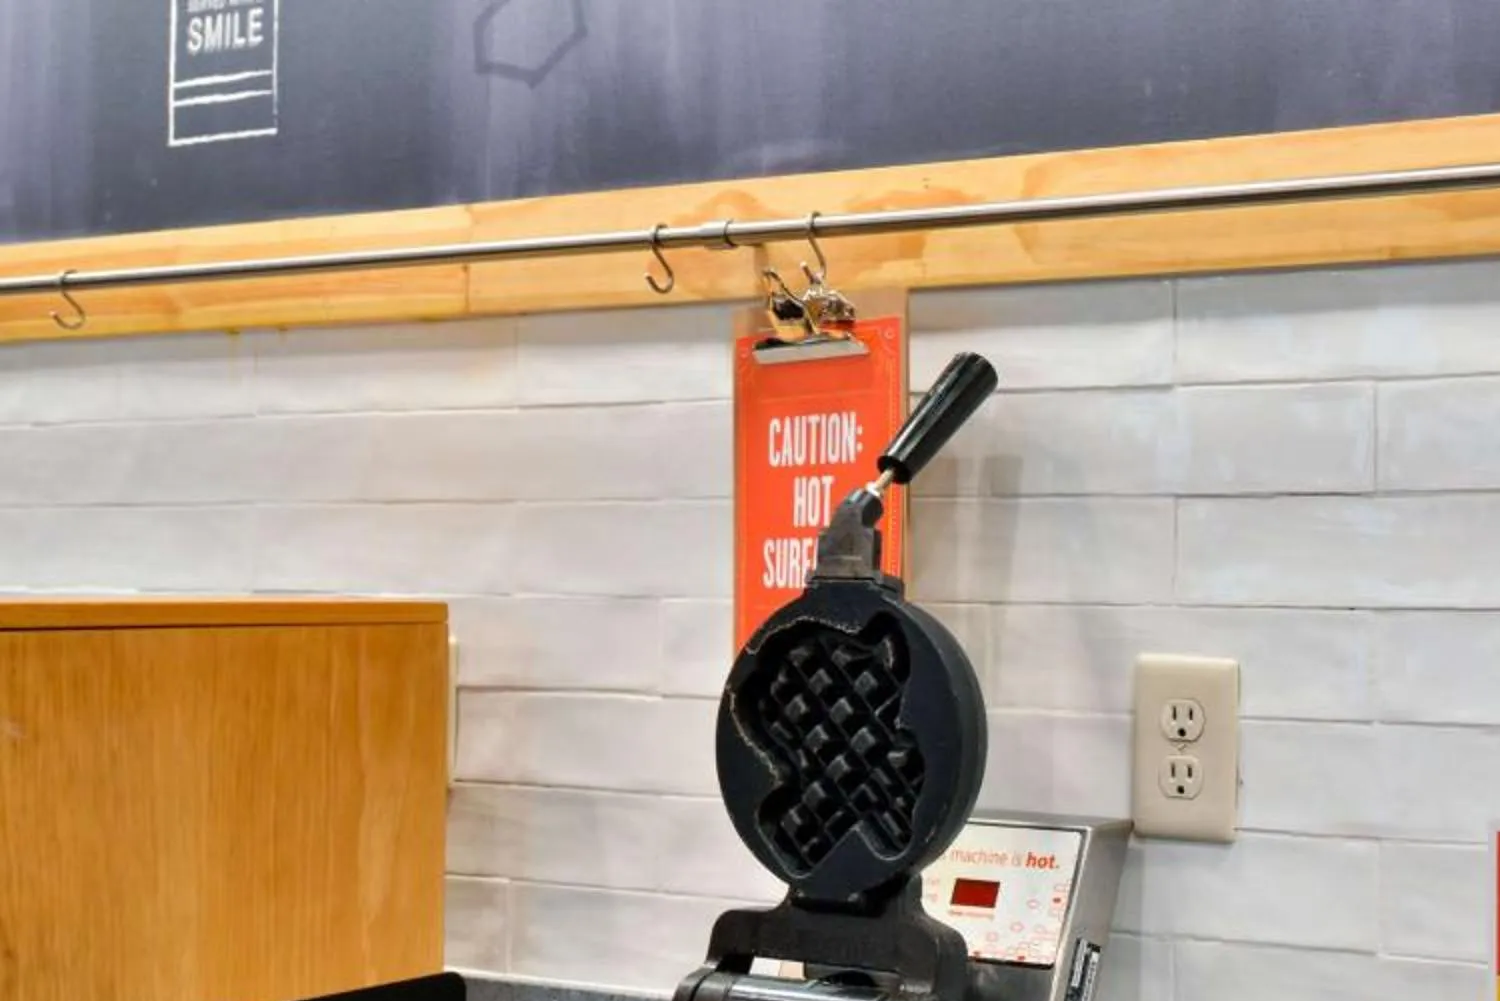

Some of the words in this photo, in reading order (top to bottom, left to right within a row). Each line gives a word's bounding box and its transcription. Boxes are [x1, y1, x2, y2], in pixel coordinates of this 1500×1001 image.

[187, 7, 264, 54] SMILE
[768, 411, 863, 467] CAUTION:
[793, 475, 835, 528] HOT
[763, 537, 819, 589] SURF
[951, 848, 1009, 866] machine
[1011, 850, 1024, 867] is
[1025, 851, 1061, 870] hot.
